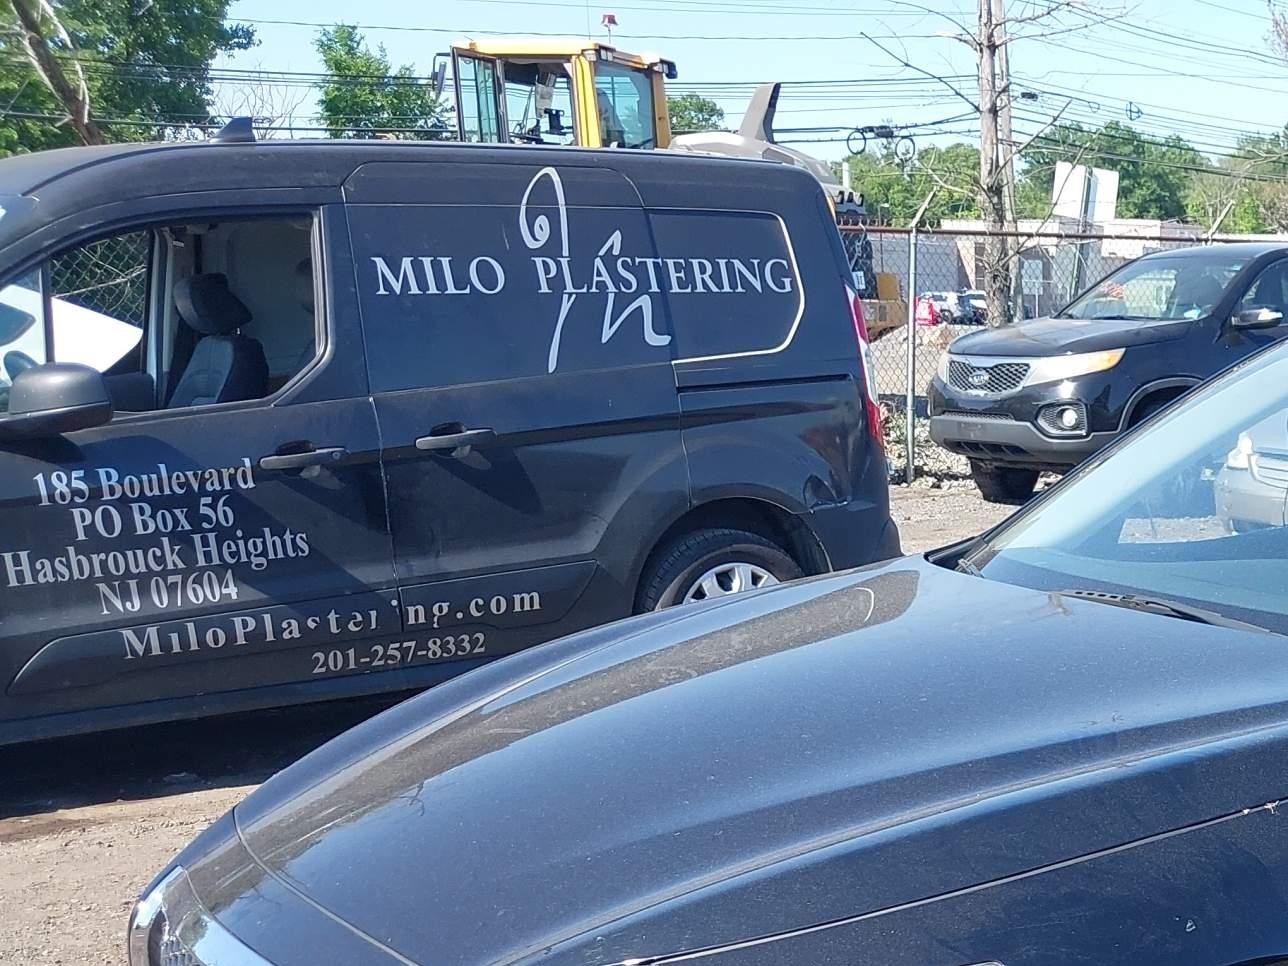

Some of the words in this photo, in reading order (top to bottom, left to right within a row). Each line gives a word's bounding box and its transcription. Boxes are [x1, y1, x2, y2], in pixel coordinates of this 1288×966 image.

[370, 256, 505, 295] MILO
[531, 256, 793, 293] PLASTERING
[33, 470, 90, 506] 185
[96, 458, 256, 501] Boulevard
[72, 505, 122, 541] PO
[130, 502, 192, 535] Box
[199, 495, 234, 529] 56
[1, 537, 187, 587] Hasbrouck
[190, 527, 310, 571] Heights
[96, 579, 142, 615] NJ
[150, 569, 239, 609] 07604
[118, 591, 542, 660] MiloPlaterng.com
[311, 632, 486, 674] 201-257-8332
